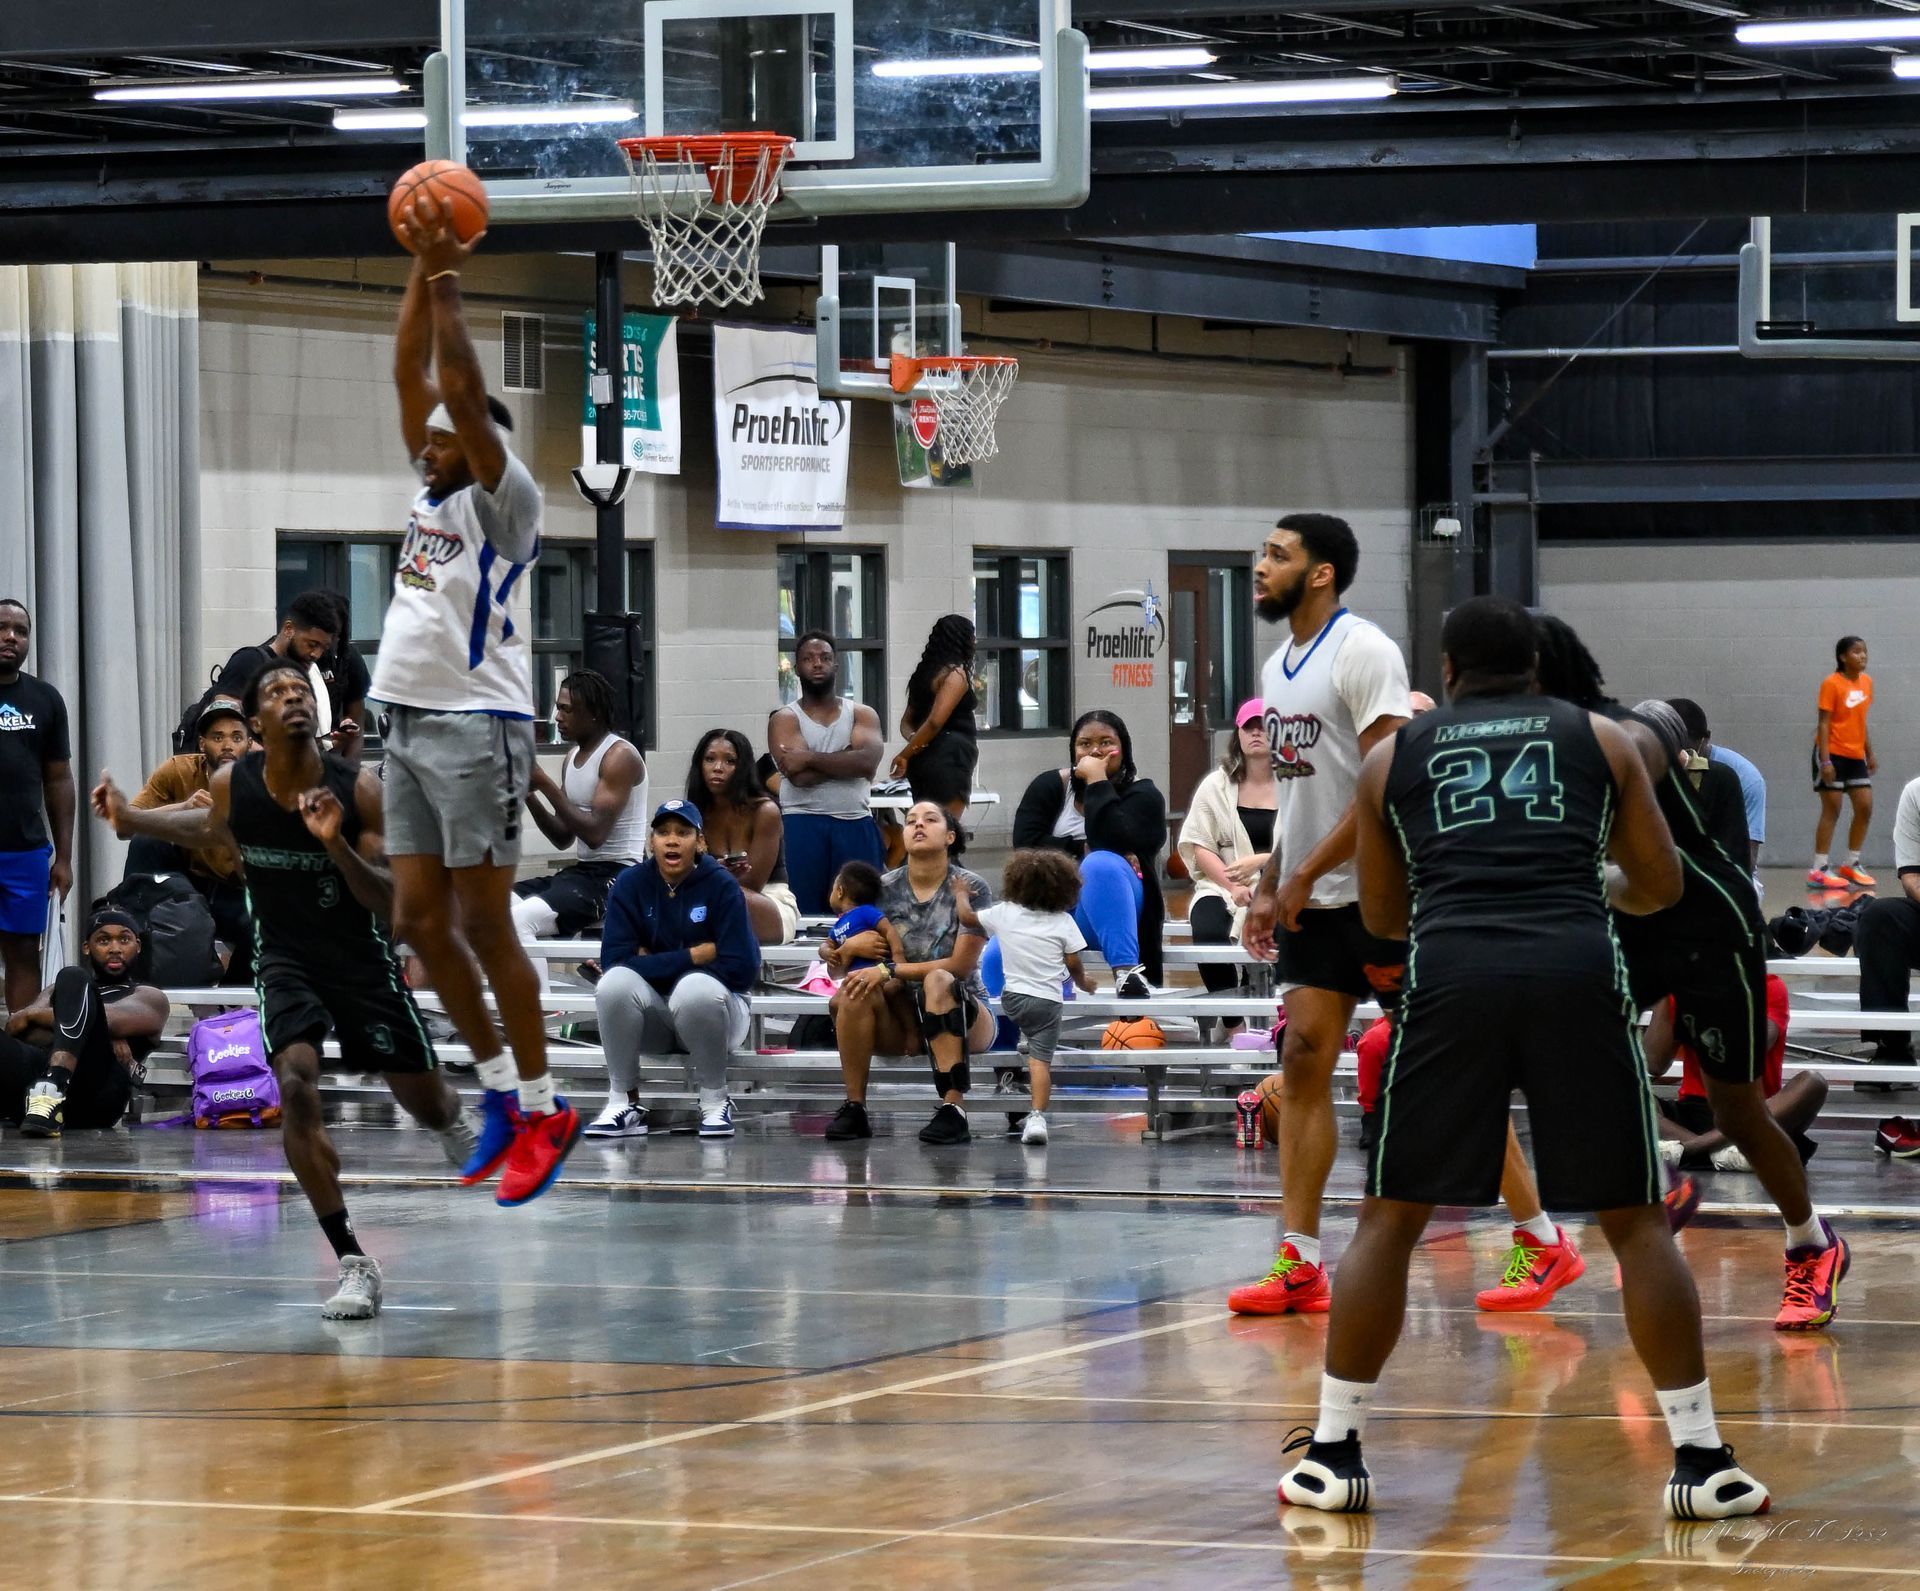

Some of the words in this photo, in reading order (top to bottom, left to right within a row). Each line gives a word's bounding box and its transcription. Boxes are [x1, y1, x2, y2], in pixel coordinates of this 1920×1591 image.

[732, 403, 829, 447] Proehlific
[1087, 626, 1155, 659] Proehlific
[1112, 663, 1153, 688] FITNESS
[1264, 706, 1322, 765] Drew
[1434, 716, 1550, 744] MOORE
[1428, 741, 1564, 833] 24
[318, 876, 340, 908] 3
[208, 1044, 251, 1064] Cookies
[213, 1089, 244, 1104] Cookies
